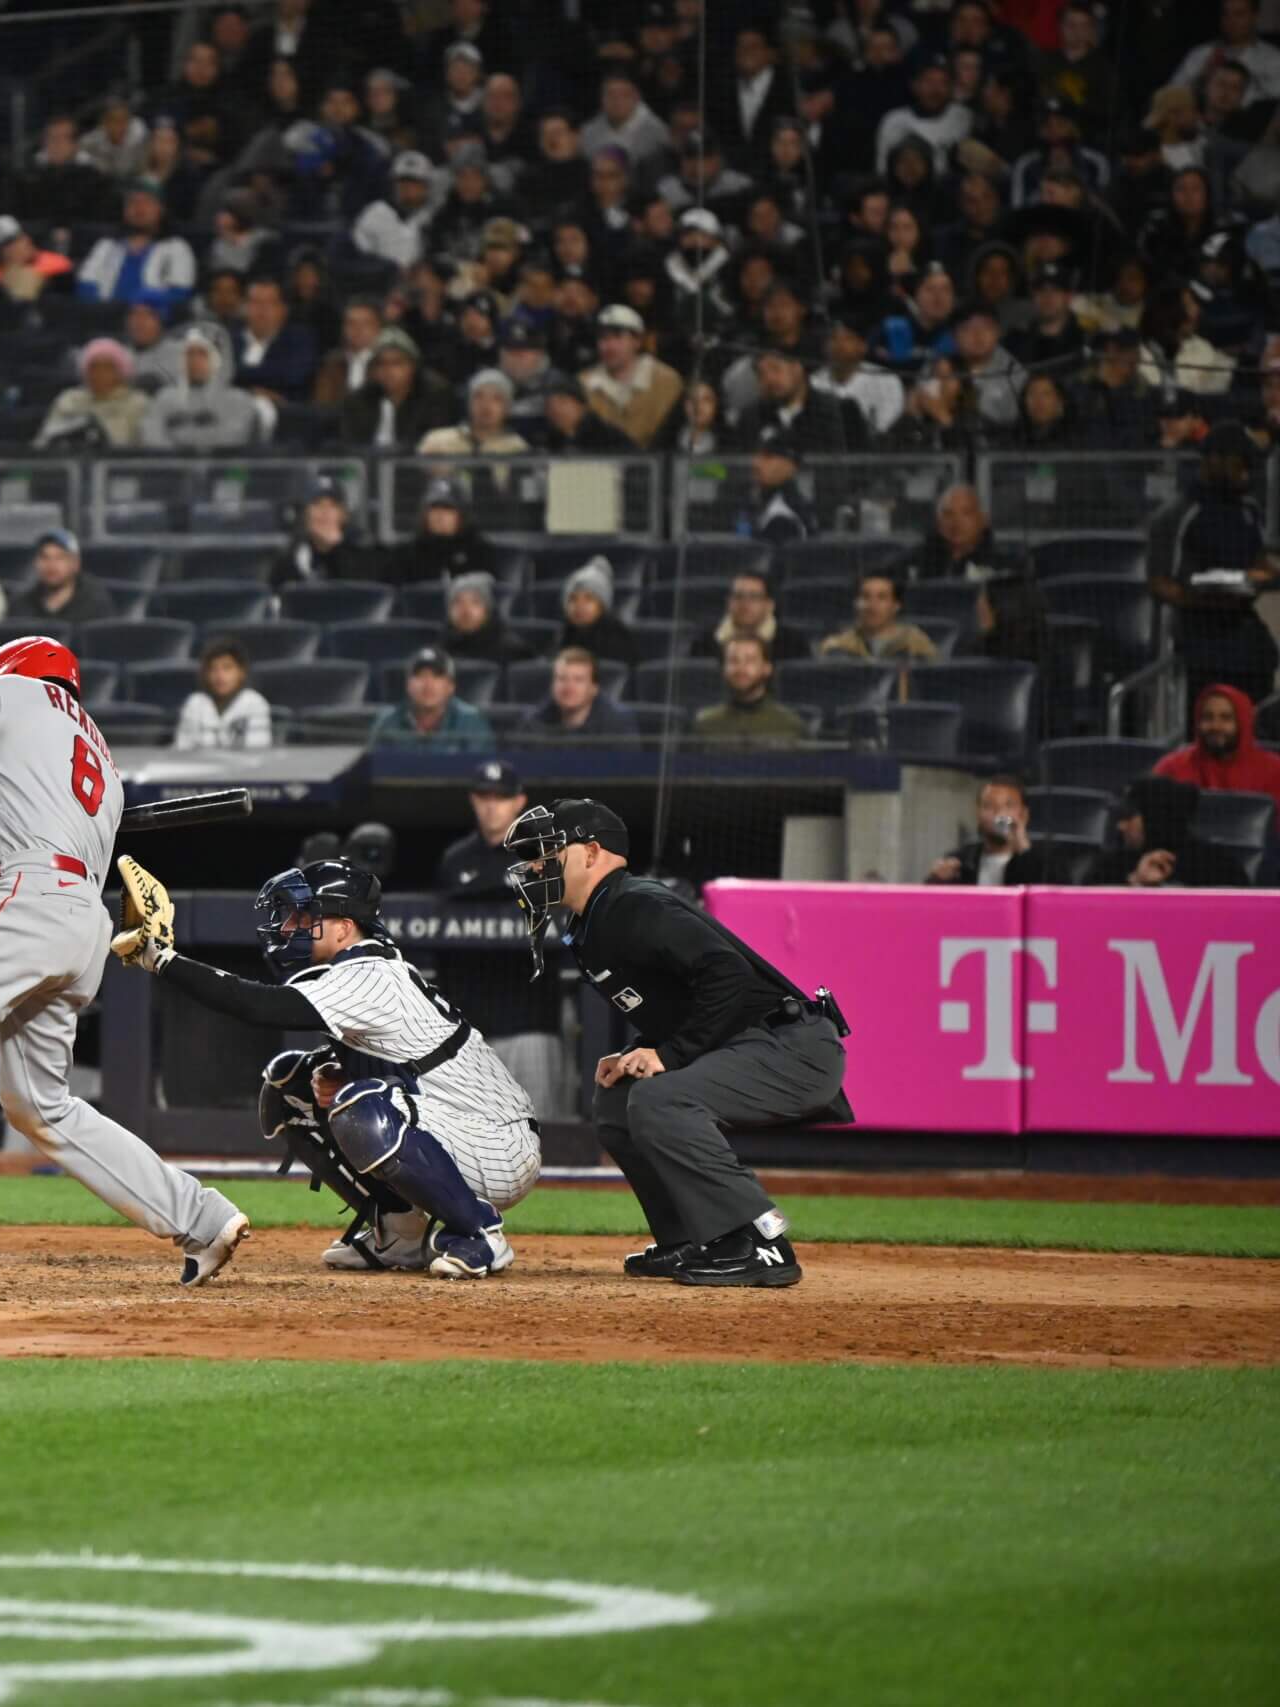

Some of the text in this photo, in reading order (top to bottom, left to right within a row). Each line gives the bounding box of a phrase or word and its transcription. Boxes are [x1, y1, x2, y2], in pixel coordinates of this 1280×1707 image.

[71, 734, 106, 817] 6
[407, 917, 441, 938] OF
[443, 918, 560, 939] AMERIA
[939, 937, 1280, 1088] T M
[755, 1246, 786, 1267] N
